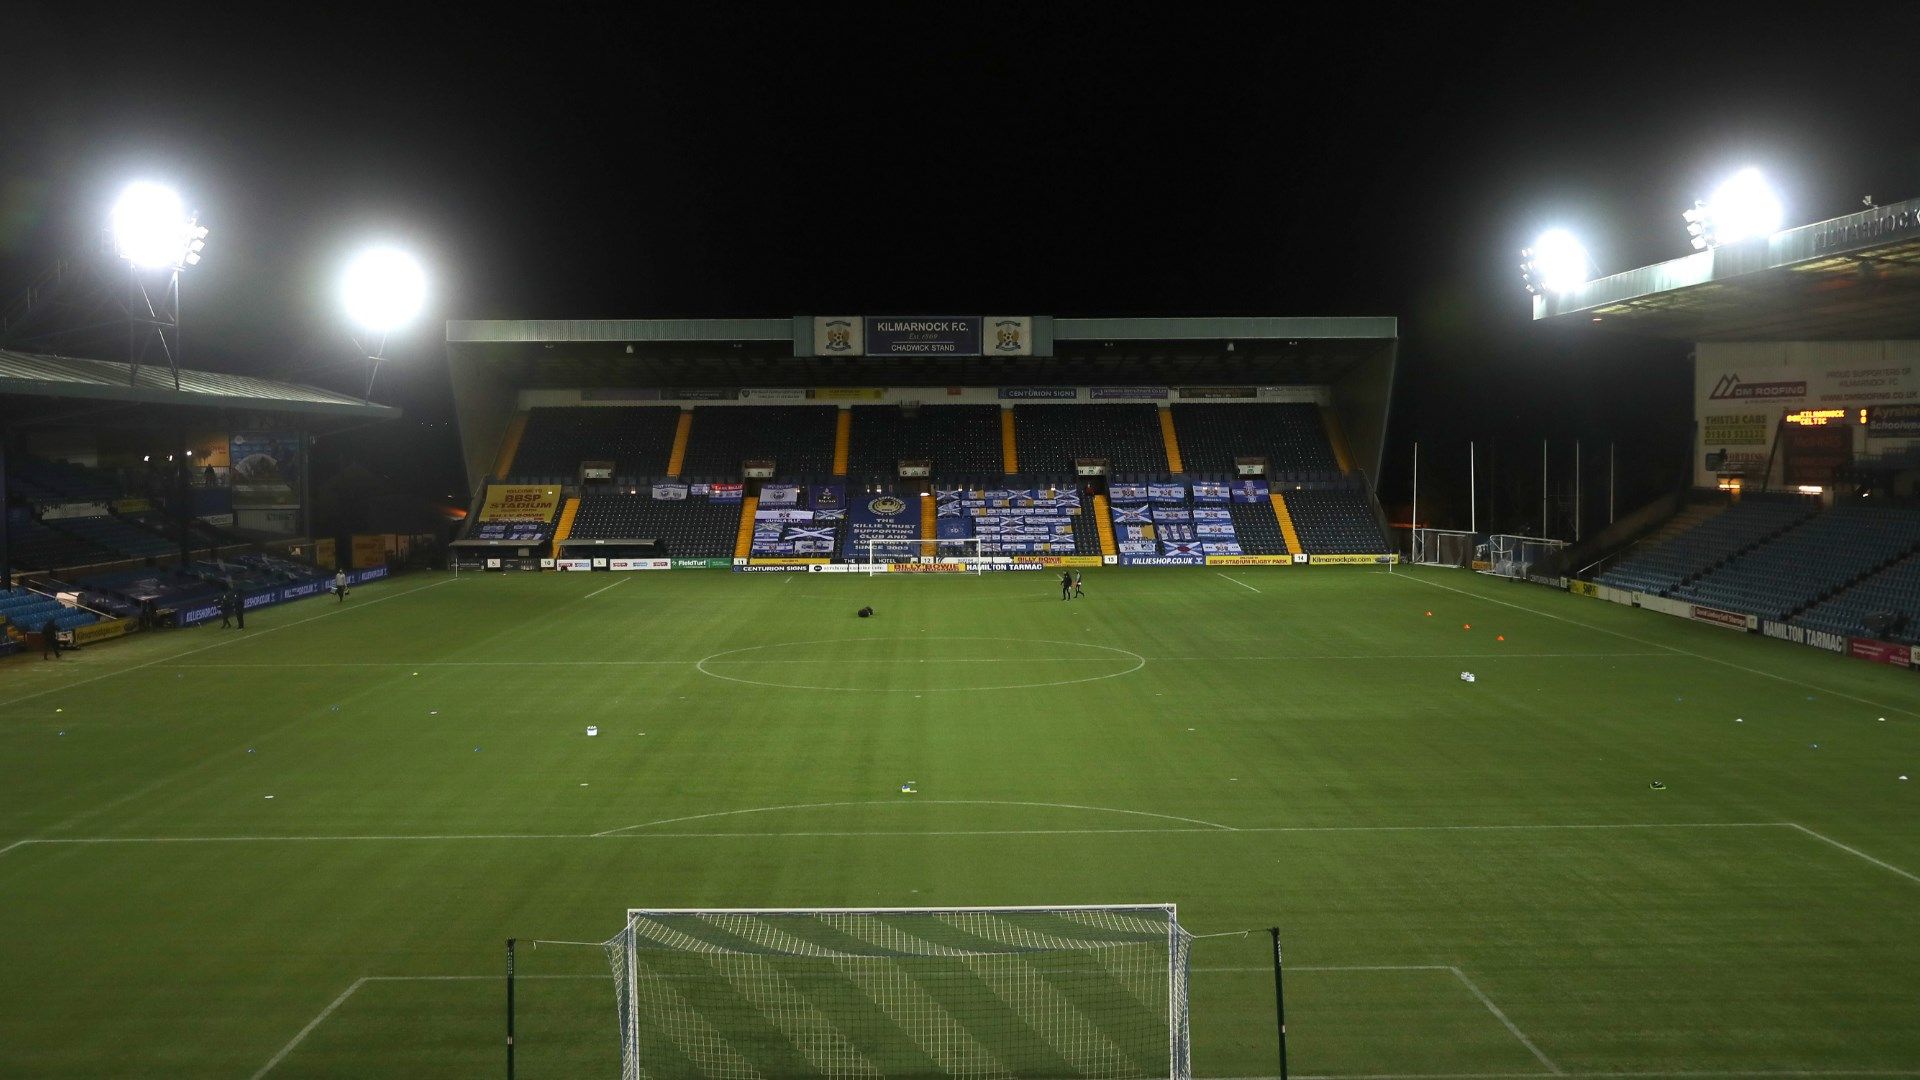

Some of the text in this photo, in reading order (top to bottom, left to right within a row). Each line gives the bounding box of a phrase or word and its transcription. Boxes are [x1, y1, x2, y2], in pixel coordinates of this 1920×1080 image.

[877, 321, 969, 332] KILMARNOCK F.C.
[891, 344, 955, 352] CHADWICK STAND
[1008, 389, 1075, 397] CENTURION SIGNS
[1755, 385, 1806, 396] ROOFING
[1800, 417, 1827, 425] CELTIC
[1131, 557, 1193, 565] KILLIESHOP.CO.UK
[1763, 620, 1804, 644] HAMILTON
[1806, 629, 1842, 652] TARMAC
